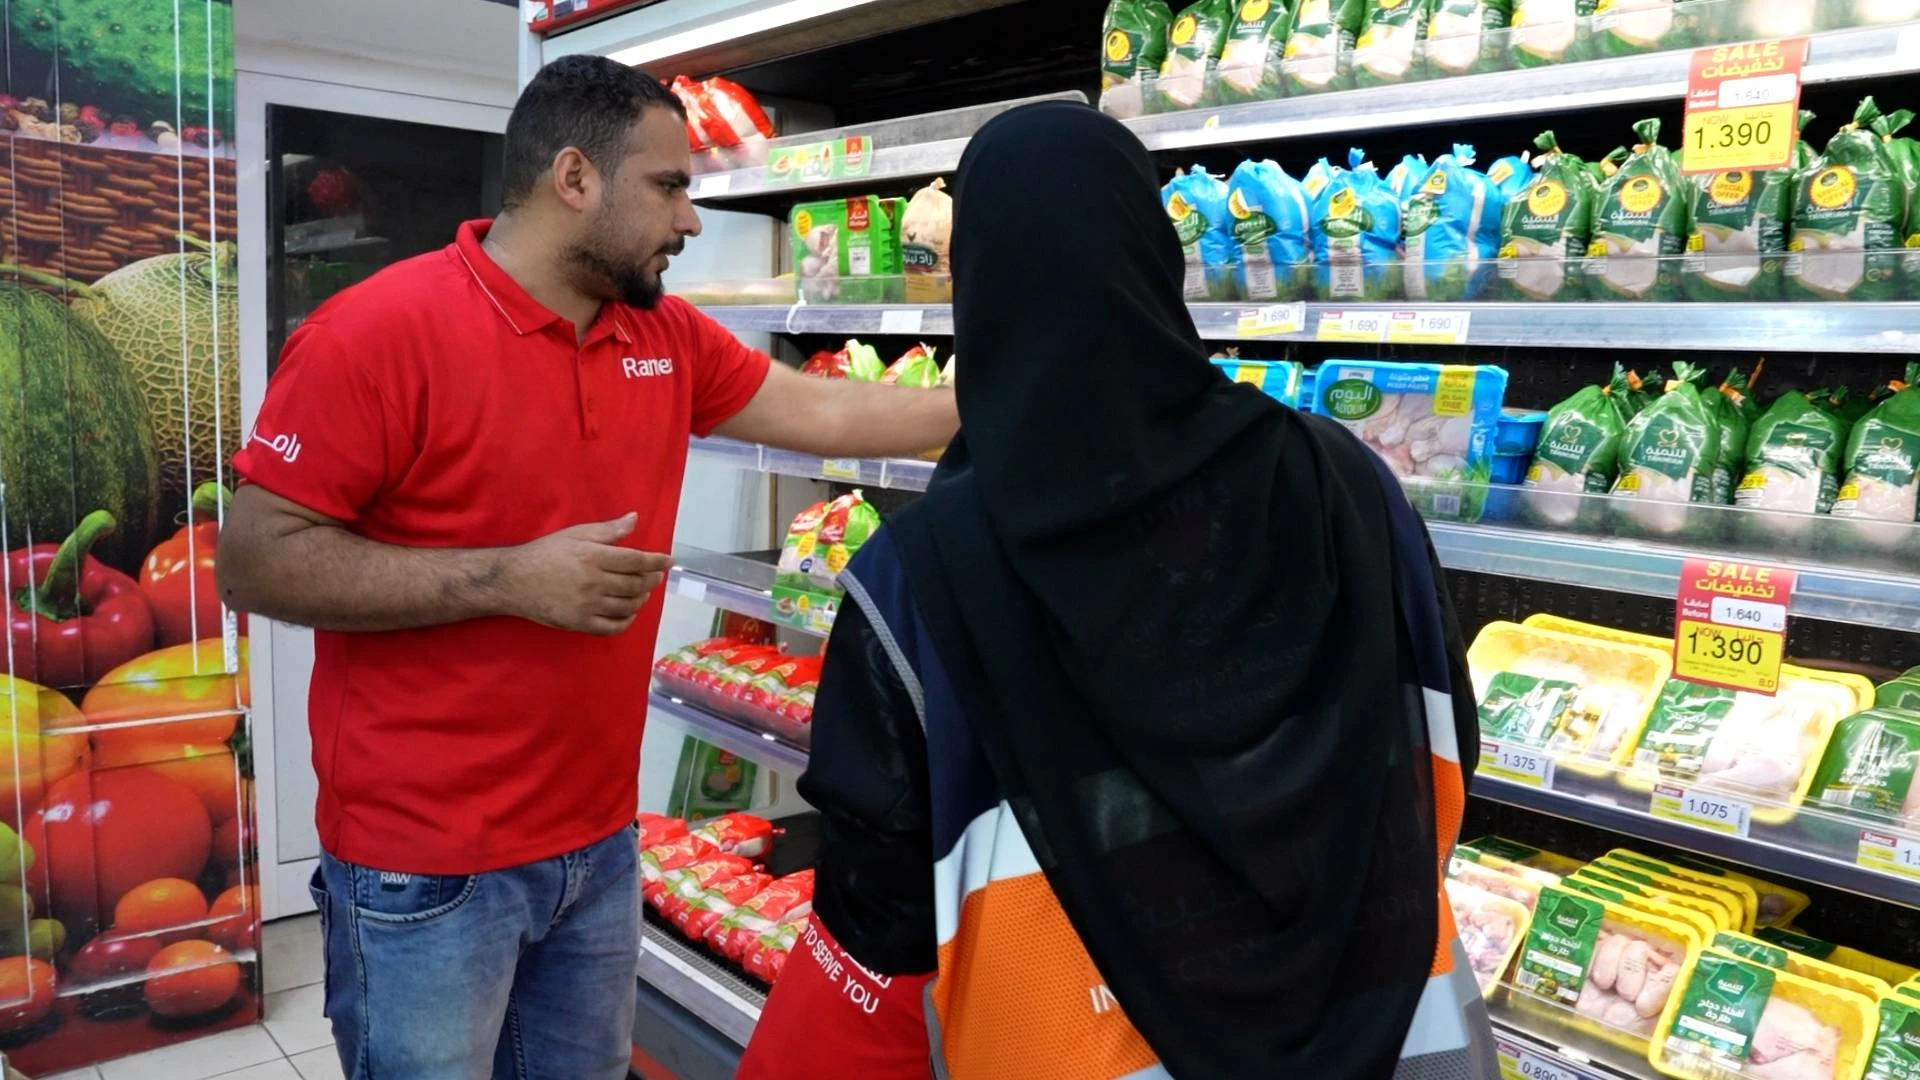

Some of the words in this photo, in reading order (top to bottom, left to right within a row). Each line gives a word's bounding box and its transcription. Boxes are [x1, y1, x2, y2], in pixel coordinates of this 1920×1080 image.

[1712, 41, 1780, 63] SALE
[1701, 56, 1785, 78] تخفيضات
[1694, 121, 1771, 149] 1.390
[1263, 309, 1290, 323] 1.690
[1349, 319, 1378, 332] 1.690
[1420, 317, 1451, 330] 1.690
[1330, 384, 1374, 403] اليوم
[1705, 561, 1773, 583] SALE
[1695, 578, 1777, 599] تخفيضات
[1726, 607, 1761, 622] 1.640
[1695, 626, 1722, 639] NOW
[1688, 631, 1762, 665] 1.390
[1503, 753, 1536, 771] 1.375
[1688, 799, 1728, 819] 1.075
[380, 872, 411, 884] RAW
[803, 924, 818, 946] TO
[812, 939, 844, 982] SERVE
[843, 974, 880, 1014] YOU
